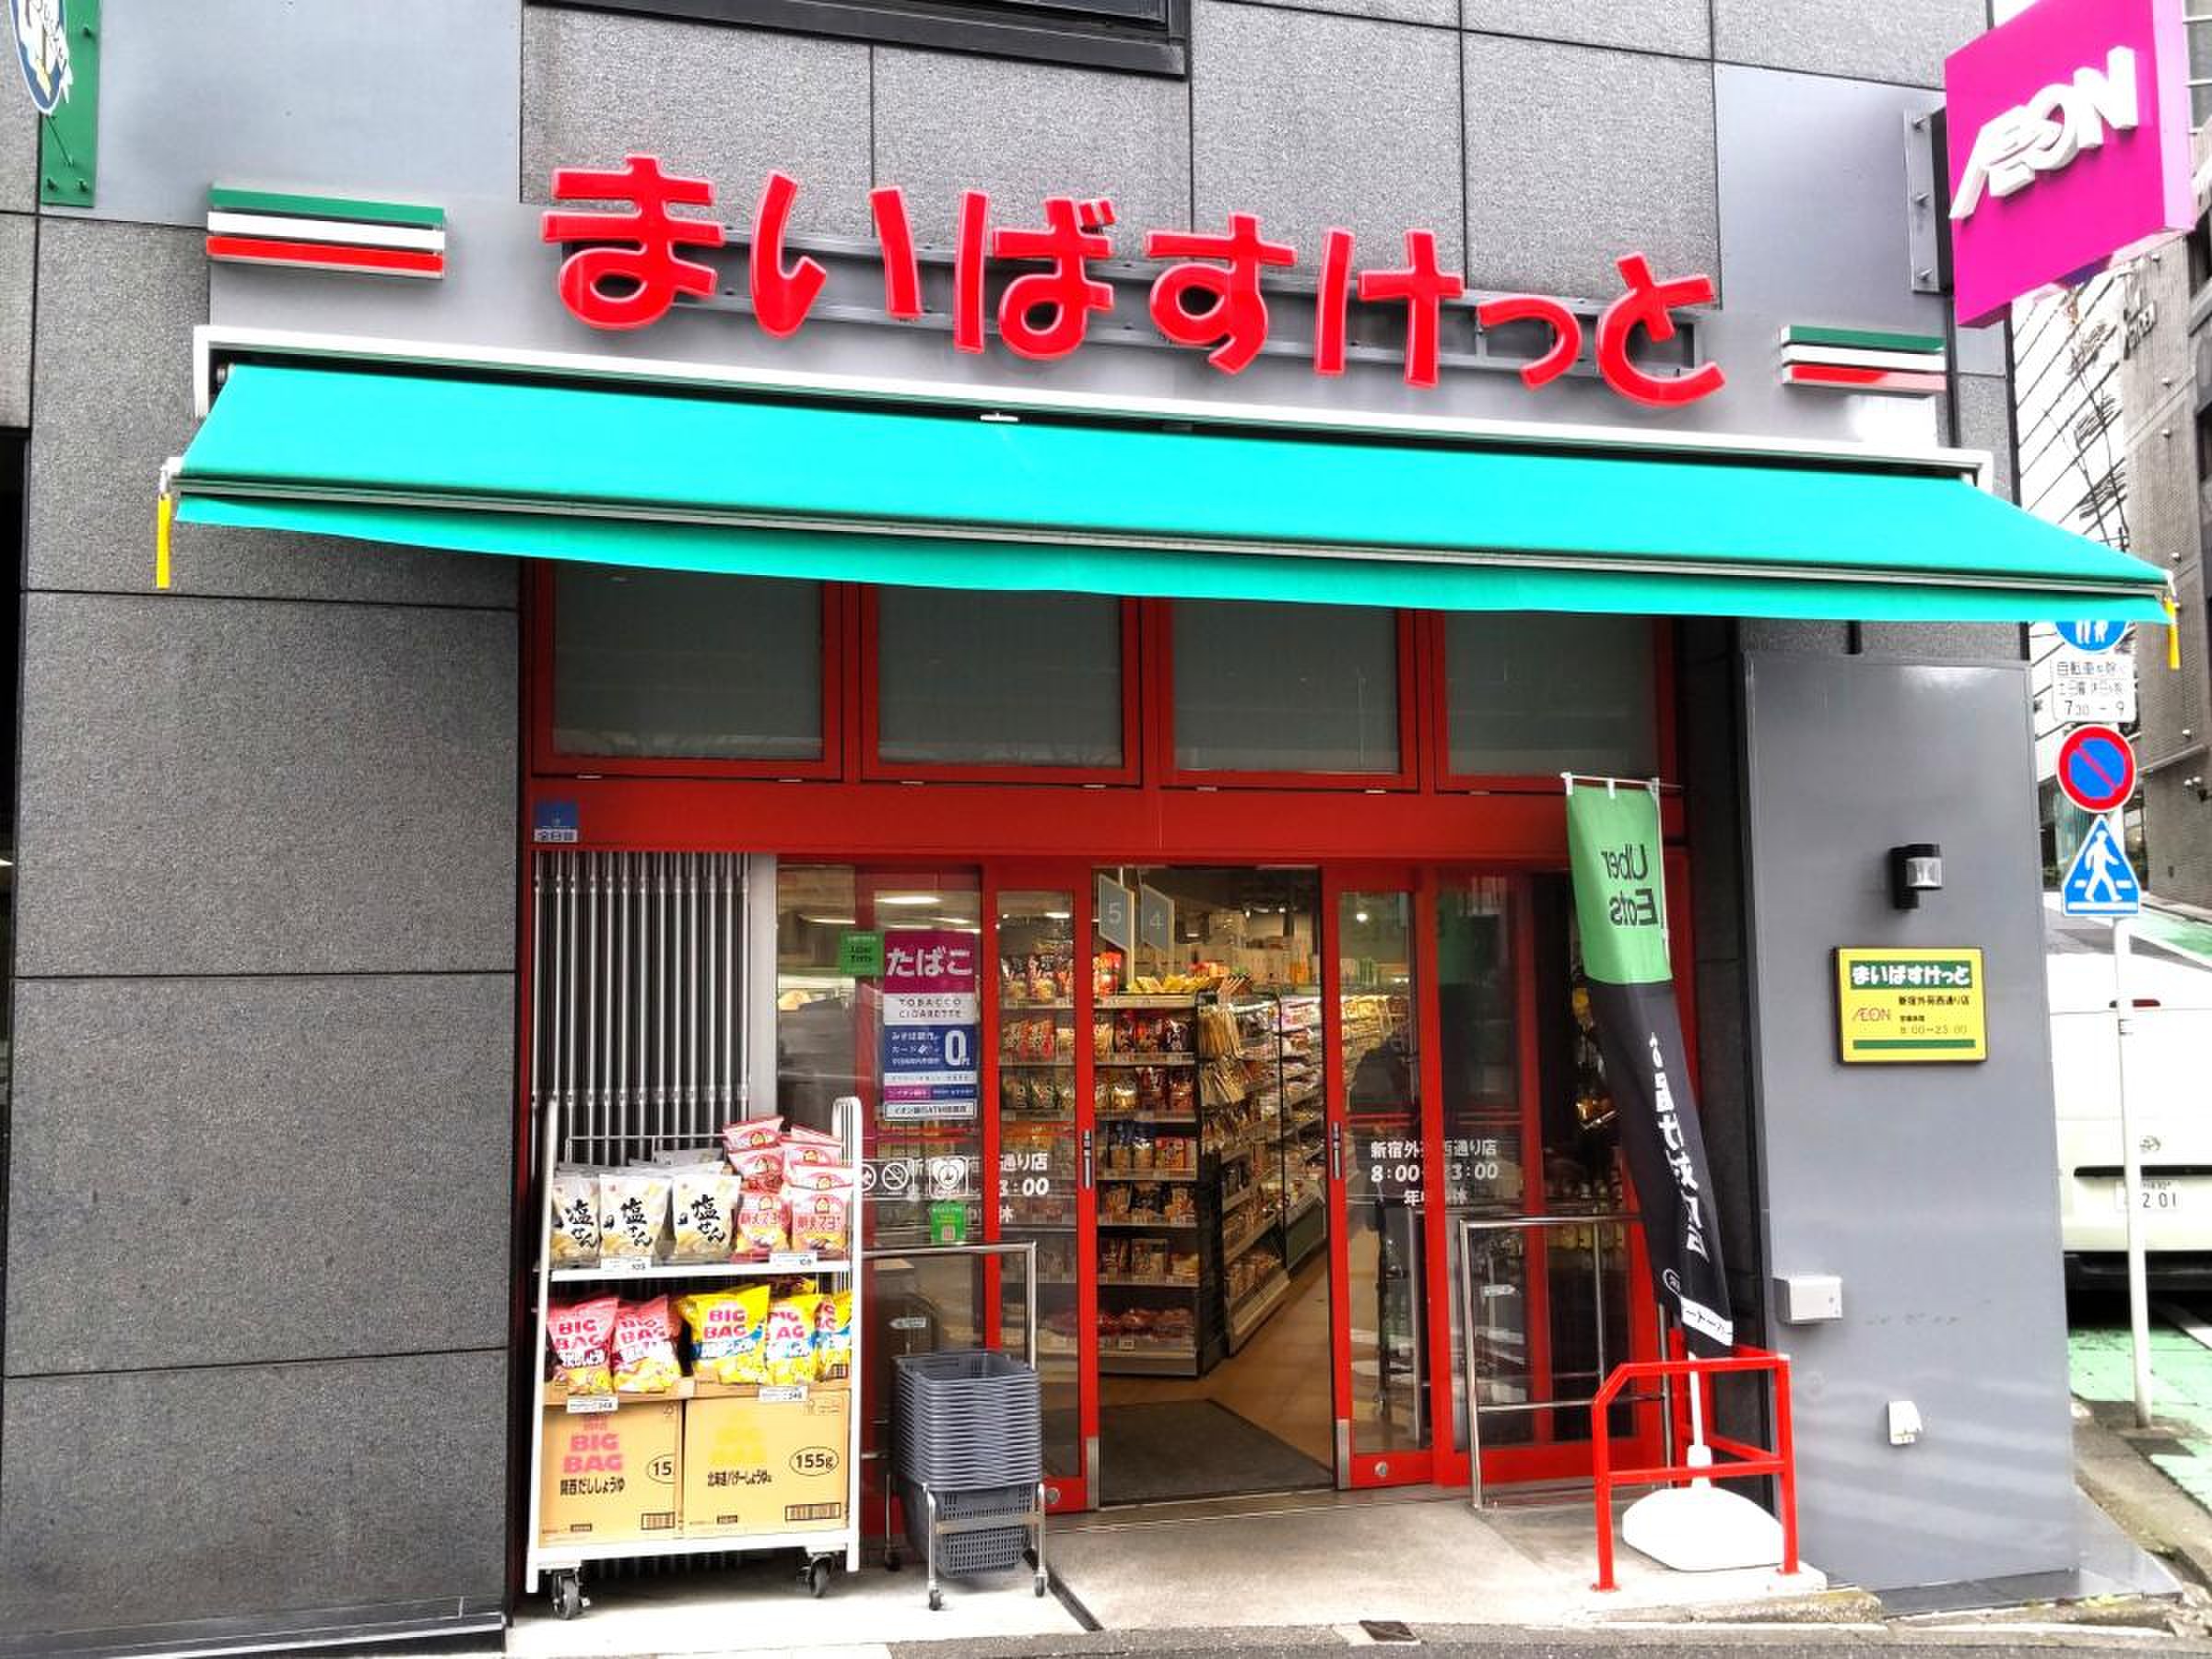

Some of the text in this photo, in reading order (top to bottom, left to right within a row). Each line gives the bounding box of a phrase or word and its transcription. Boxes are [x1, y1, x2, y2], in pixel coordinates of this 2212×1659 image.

[542, 154, 1725, 409] まいばすけっと
[886, 946, 972, 977] たばこ
[1853, 965, 1971, 986] まいばすけっと
[620, 1318, 657, 1328] BIG
[709, 1310, 746, 1323] BIG
[559, 1319, 597, 1335] BIG
[703, 1326, 747, 1339] BAG
[555, 1335, 604, 1351] BAG
[620, 1328, 665, 1343] BAG
[571, 1433, 620, 1452] BIG
[564, 1454, 623, 1474] BAG
[795, 1453, 834, 1469] 155g
